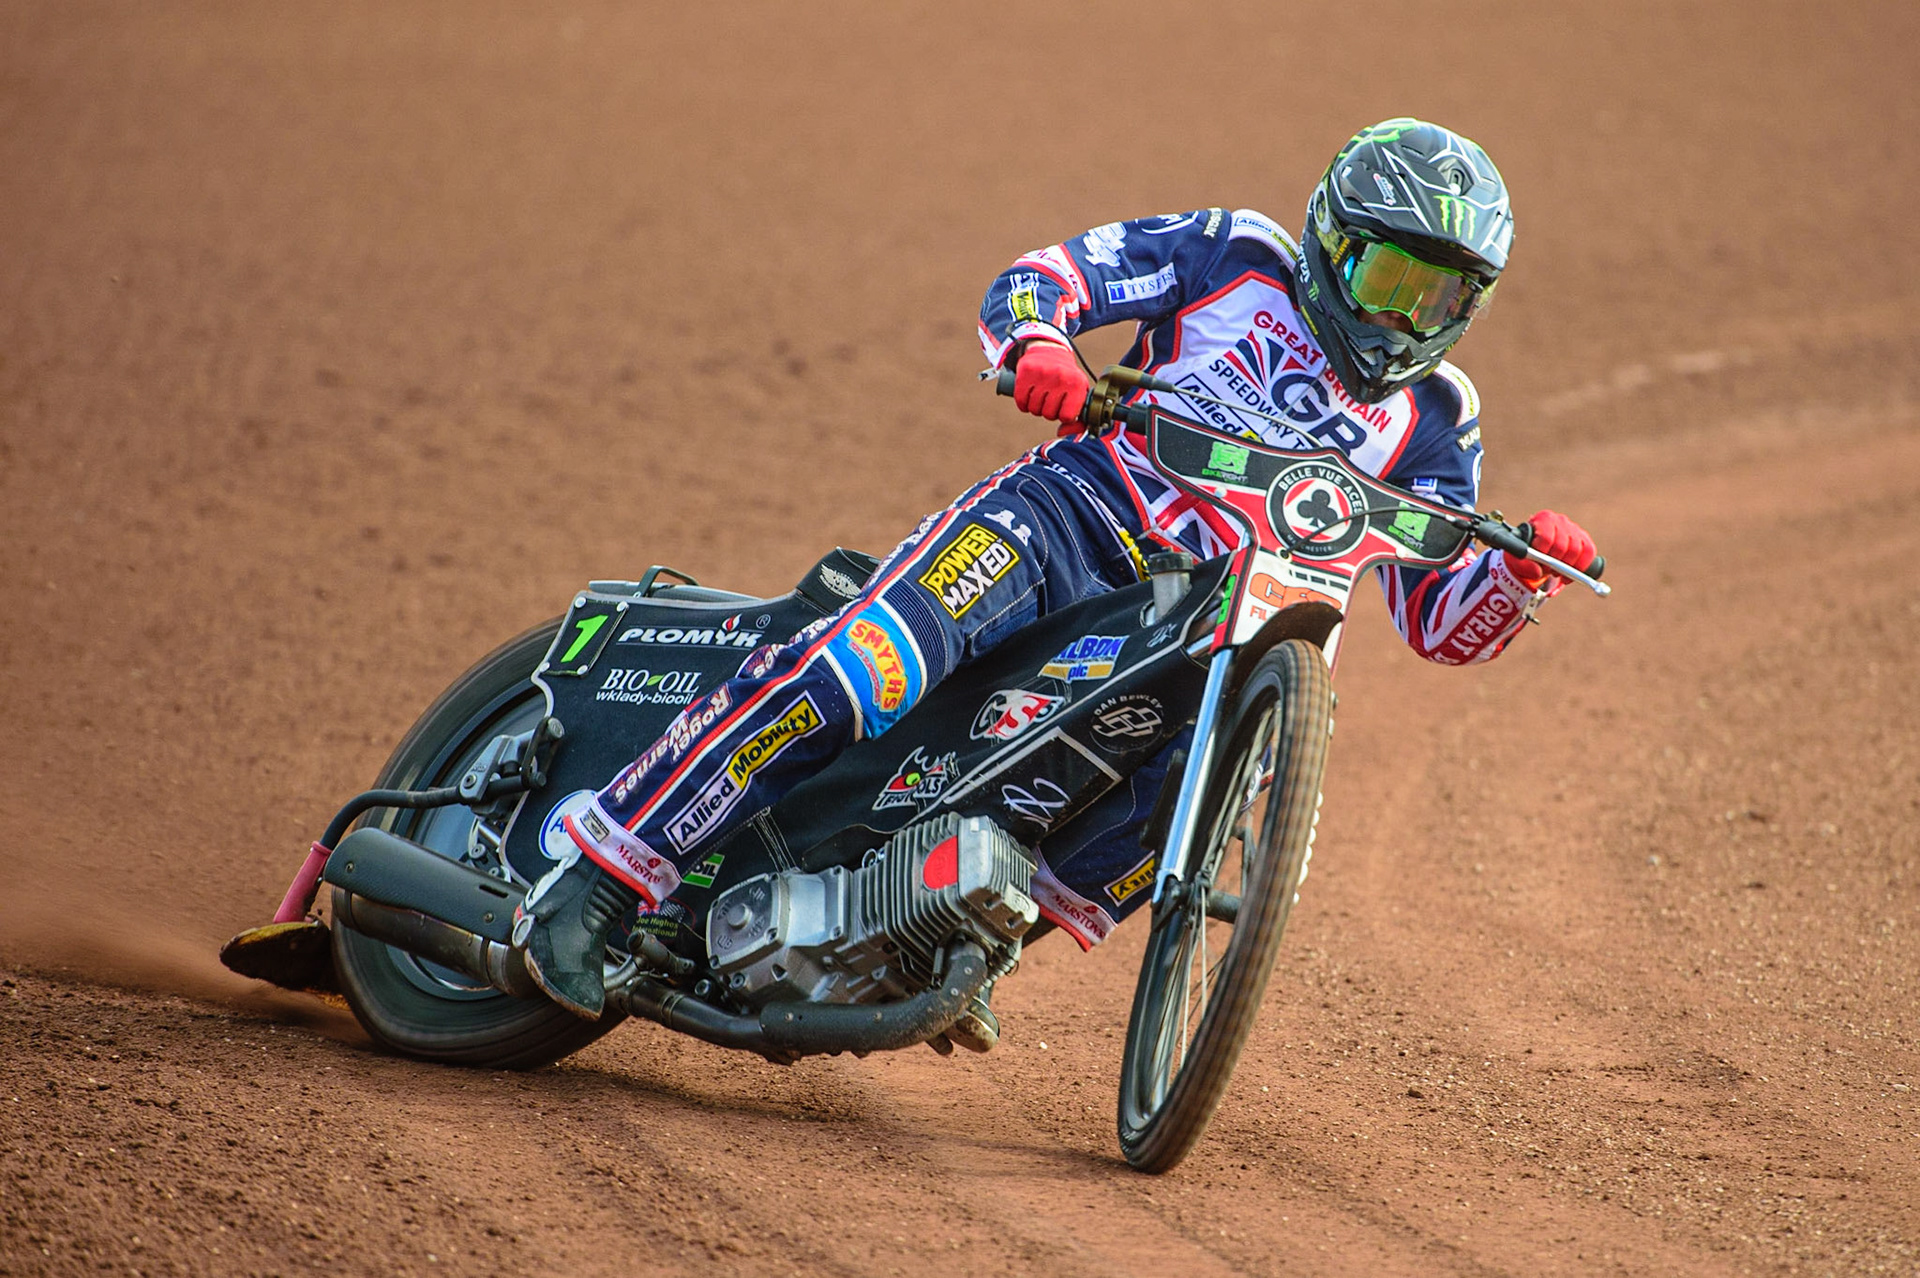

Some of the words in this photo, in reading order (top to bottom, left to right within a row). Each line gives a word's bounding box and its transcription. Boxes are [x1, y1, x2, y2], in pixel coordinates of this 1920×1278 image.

[1253, 310, 1323, 366] GREAT
[1181, 384, 1243, 434] Allied
[1209, 358, 1294, 439] SPEEDWAY
[1324, 367, 1392, 434] BRITAIN
[1278, 467, 1313, 491] BELLE
[1318, 467, 1343, 485] VUE
[1343, 486, 1364, 514] ACES
[927, 528, 996, 596] POWER
[943, 543, 1011, 613] MAXED
[561, 614, 608, 663] 1
[1450, 593, 1514, 656] GREAT
[601, 668, 650, 692] BIO
[658, 670, 701, 693] OIL
[850, 622, 903, 708] SMYTHS
[671, 686, 731, 763] Roger
[1094, 697, 1117, 716] DAN
[1120, 694, 1163, 708] BEWLEY
[614, 716, 689, 803] Warnes
[679, 777, 735, 843] Allied
[732, 708, 812, 781] Mobility
